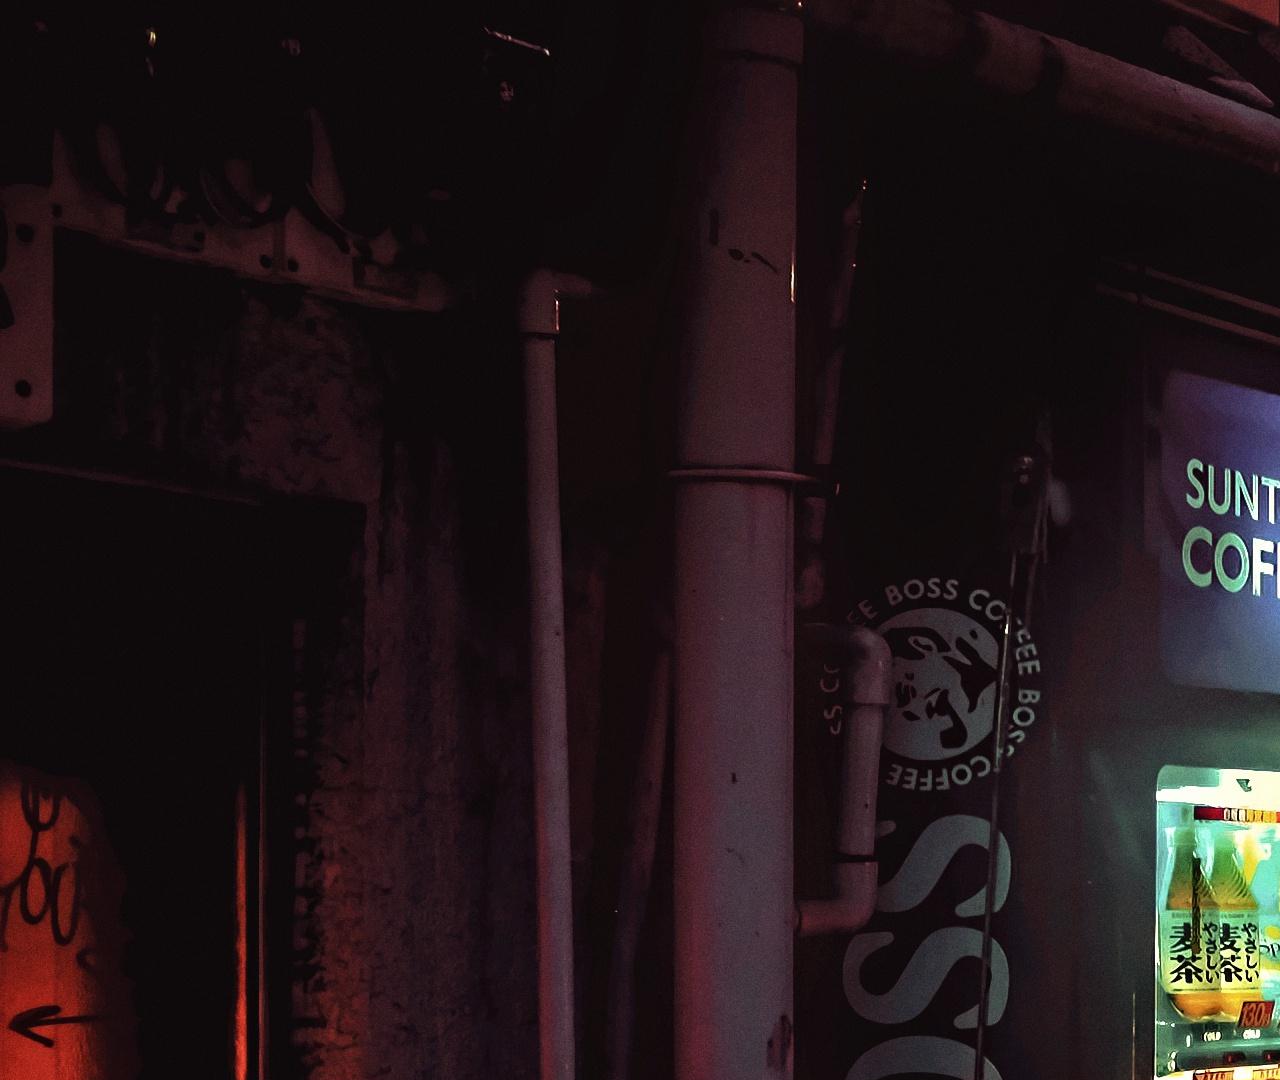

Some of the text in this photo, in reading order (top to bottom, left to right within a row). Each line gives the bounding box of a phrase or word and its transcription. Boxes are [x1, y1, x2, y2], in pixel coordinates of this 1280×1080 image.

[884, 577, 959, 606] BOSS
[968, 588, 1041, 676] COFEE
[884, 756, 992, 792] COFFEE
[1169, 922, 1203, 985] 麦茶
[1201, 923, 1220, 984] やさしい
[1217, 922, 1243, 983] 麦茶
[1241, 922, 1260, 983] やさしい
